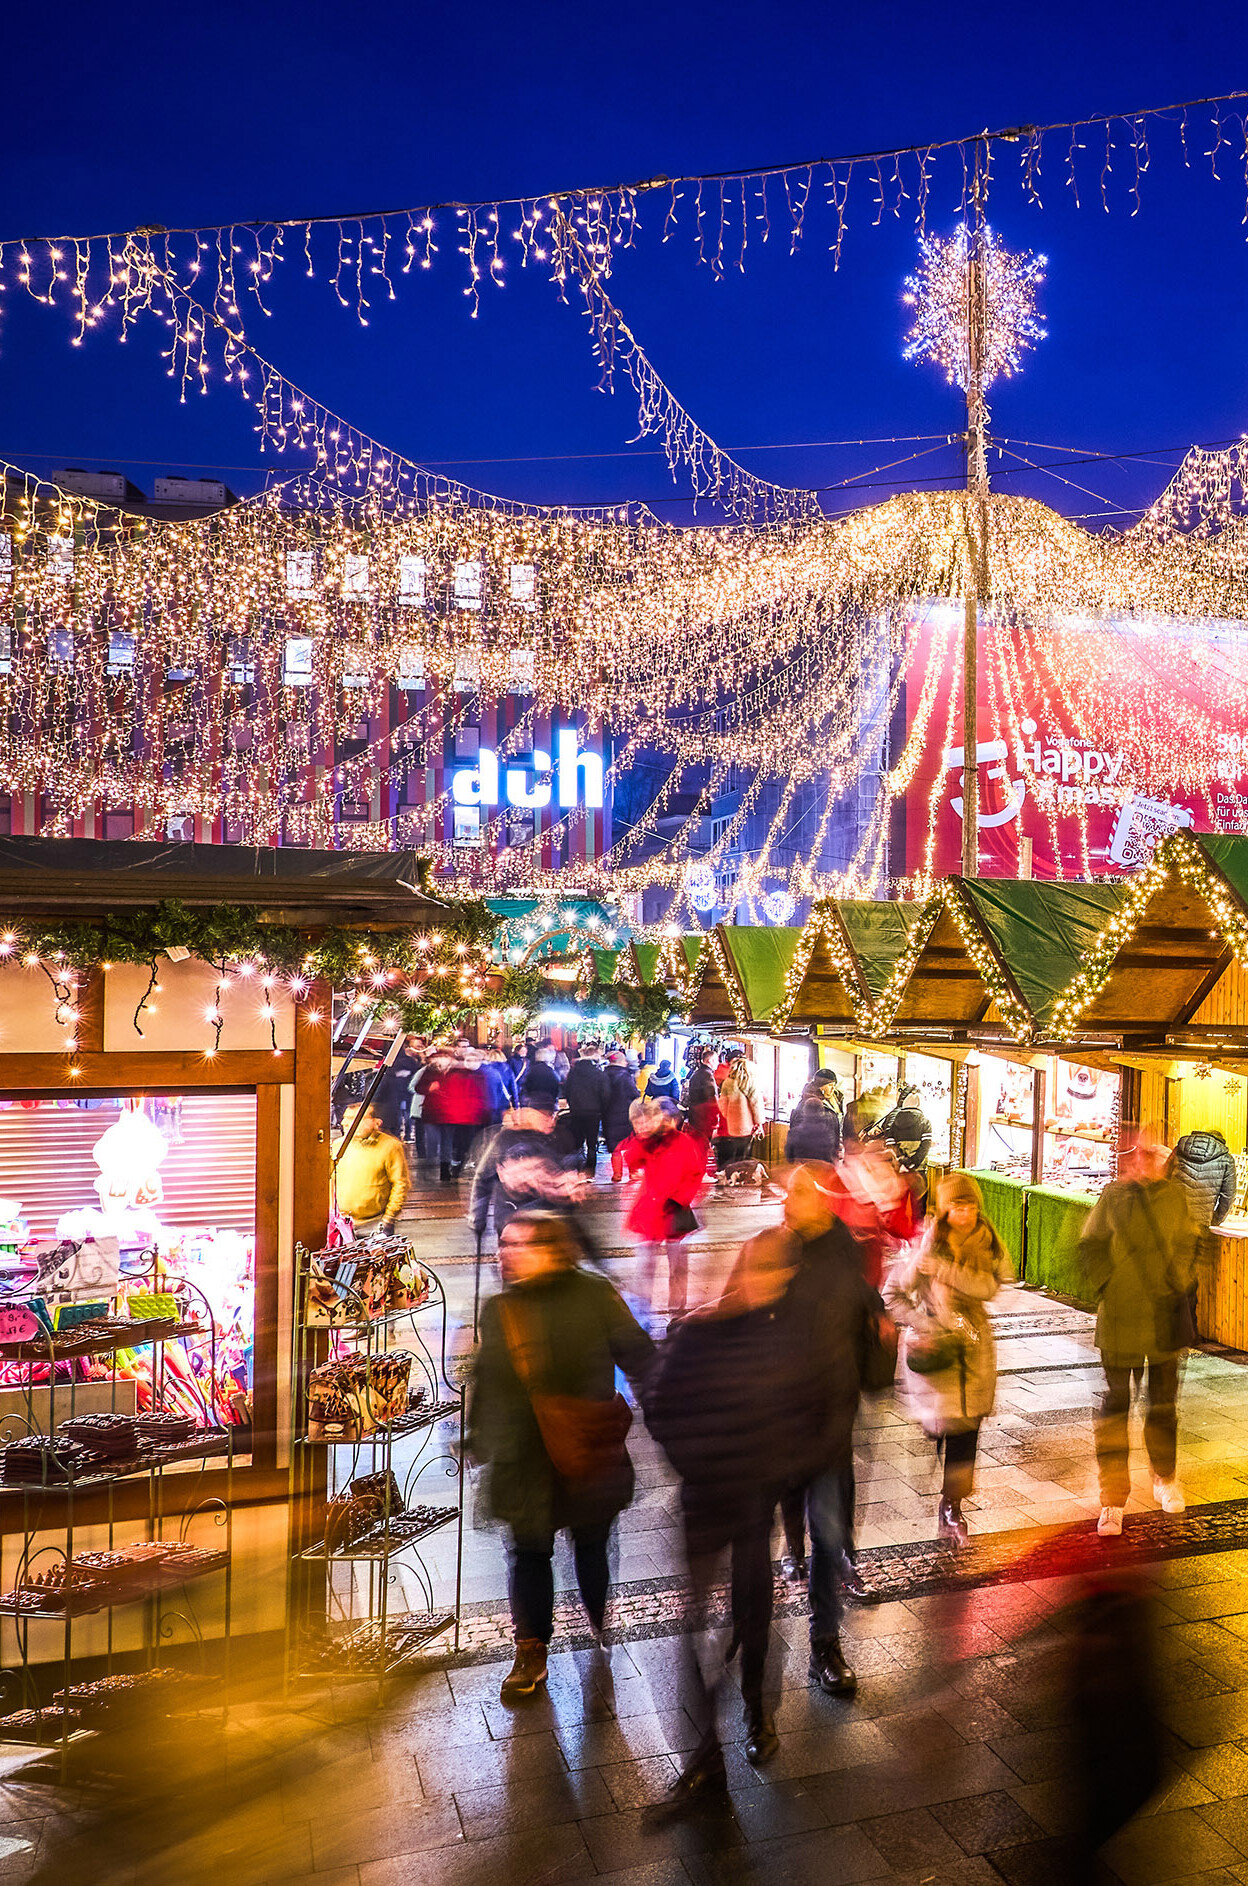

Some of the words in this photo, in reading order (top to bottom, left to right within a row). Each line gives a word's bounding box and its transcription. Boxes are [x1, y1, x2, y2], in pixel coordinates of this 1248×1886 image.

[1045, 735, 1094, 747] Vodafone
[1016, 740, 1124, 783] Happy
[1036, 778, 1116, 804] Xmas
[1217, 793, 1234, 804] Das
[1217, 806, 1230, 817] für
